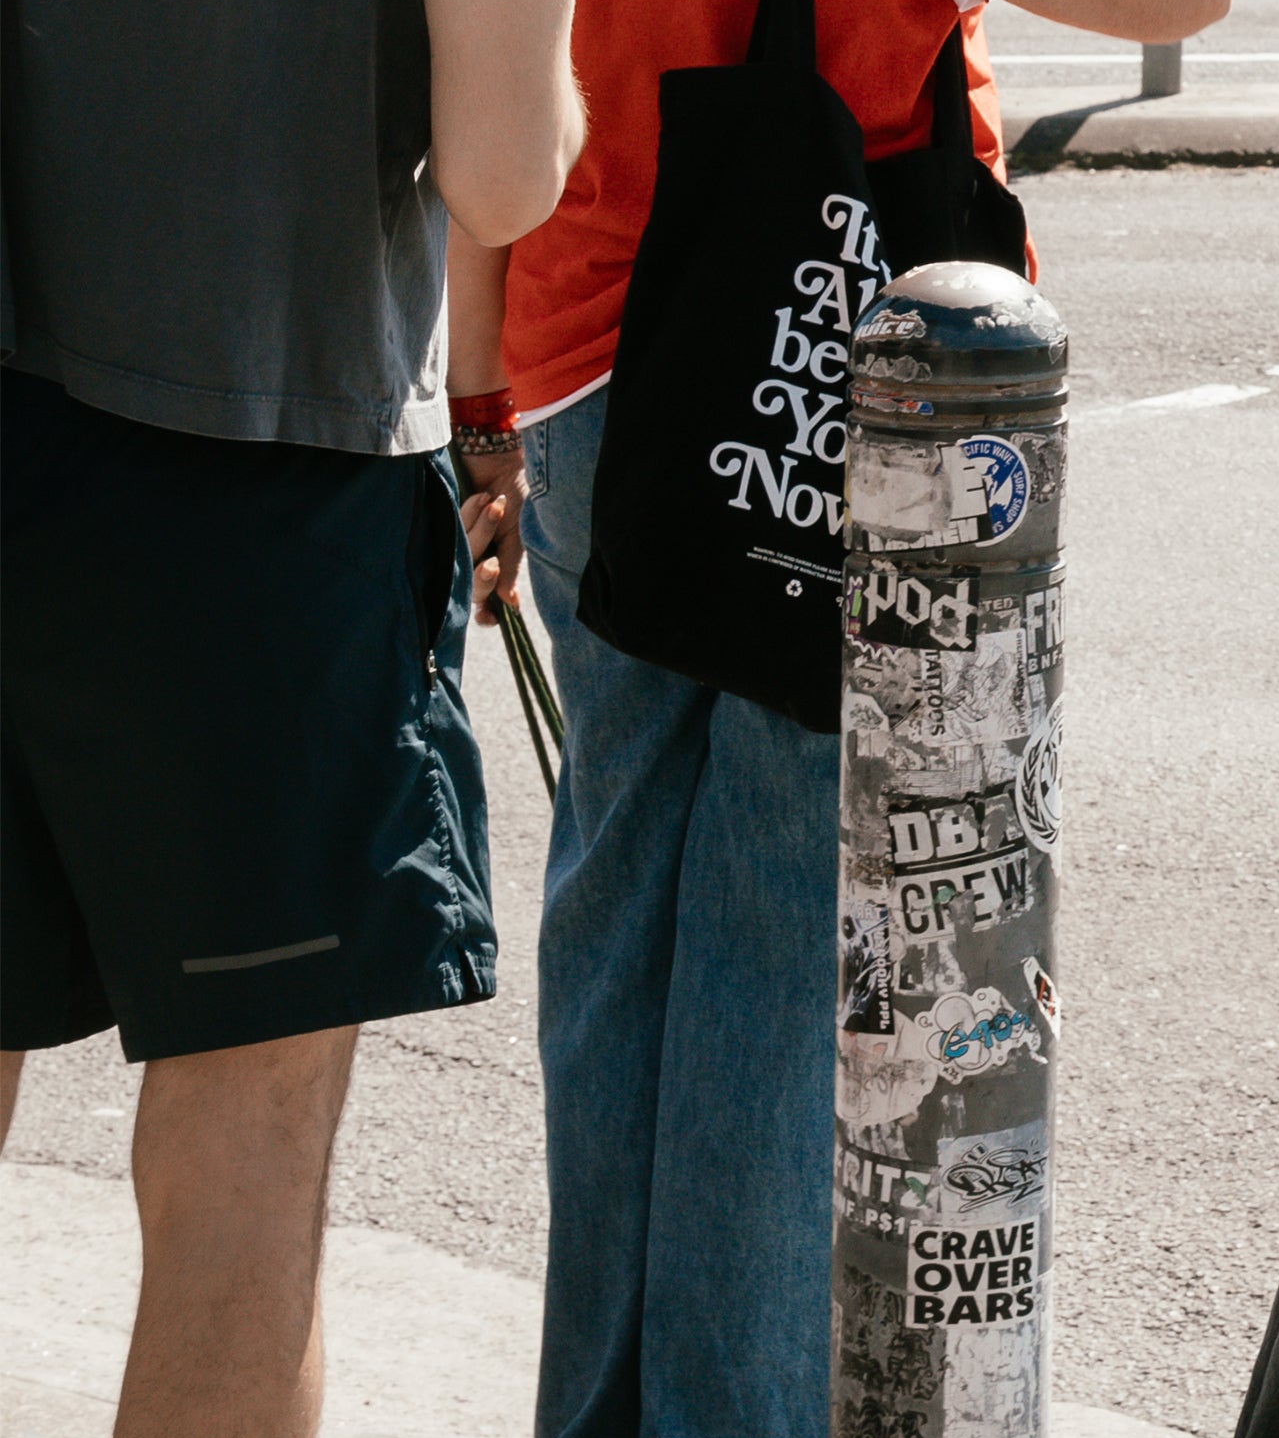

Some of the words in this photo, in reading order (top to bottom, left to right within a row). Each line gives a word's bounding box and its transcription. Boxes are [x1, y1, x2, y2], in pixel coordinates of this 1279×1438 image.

[822, 194, 879, 271] It
[771, 308, 848, 384] be
[992, 444, 1015, 465] WAVE
[1013, 470, 1024, 496] SURF
[1006, 497, 1022, 523] SHOP
[901, 858, 1027, 935] CREW
[914, 1221, 1034, 1260] CRAVE
[914, 1256, 1032, 1292] OVER
[914, 1286, 1034, 1325] BARS
